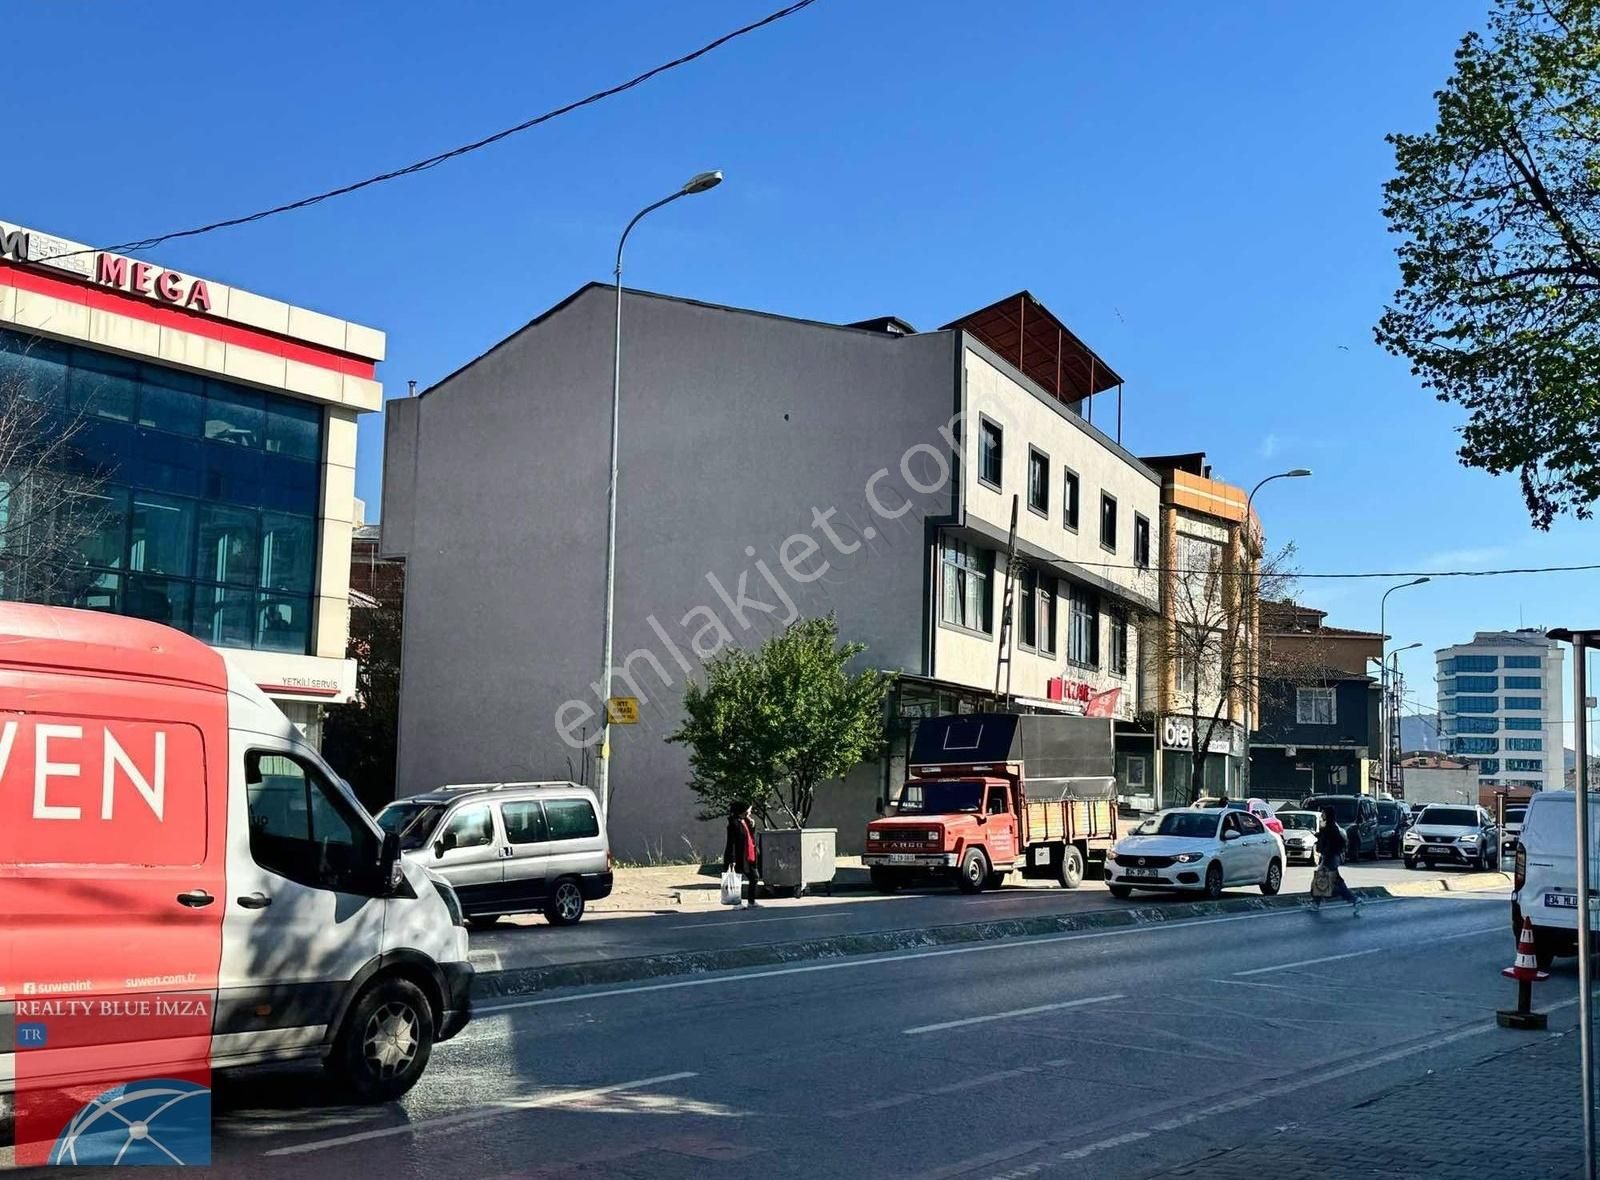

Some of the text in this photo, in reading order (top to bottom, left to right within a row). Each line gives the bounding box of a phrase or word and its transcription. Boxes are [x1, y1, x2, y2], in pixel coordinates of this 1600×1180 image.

[97, 252, 211, 312] MEGA
[38, 980, 93, 994] suwenint
[125, 973, 197, 988] suwen.com.tr
